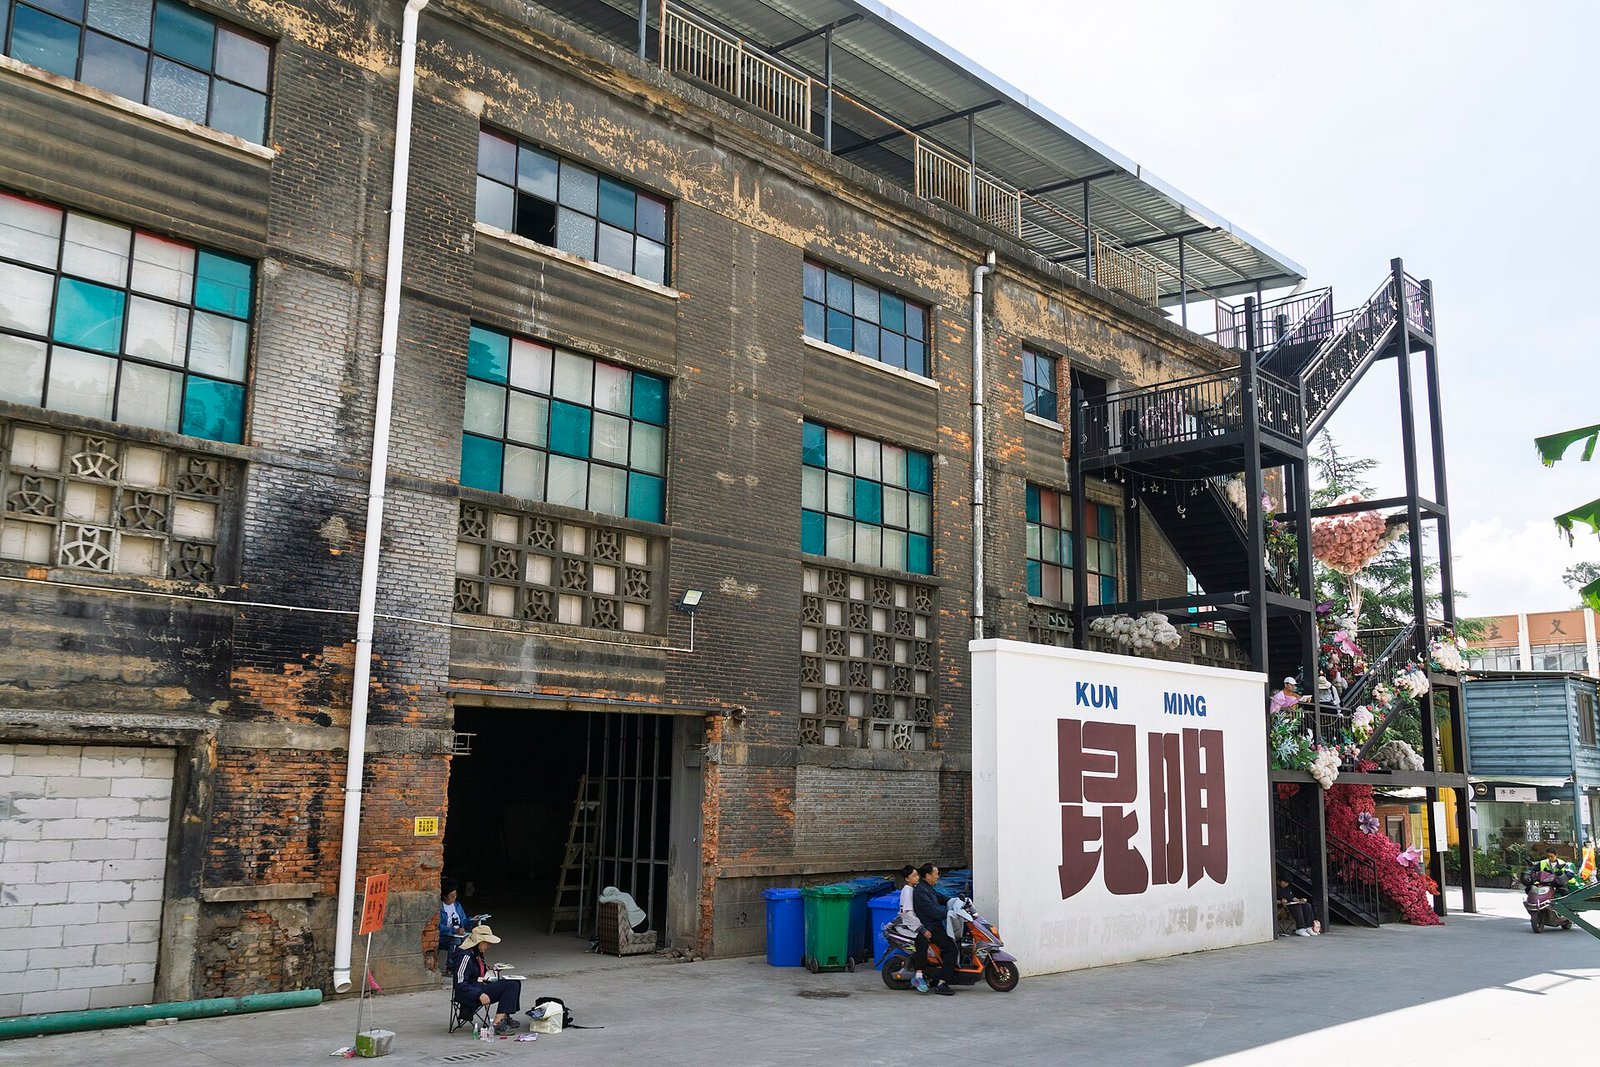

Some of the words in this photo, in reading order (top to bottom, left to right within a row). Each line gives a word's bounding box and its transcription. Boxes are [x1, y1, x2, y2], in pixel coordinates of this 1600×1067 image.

[1075, 681, 1118, 710] KUN
[1163, 691, 1207, 717] MING
[1057, 718, 1228, 900] 昆明
